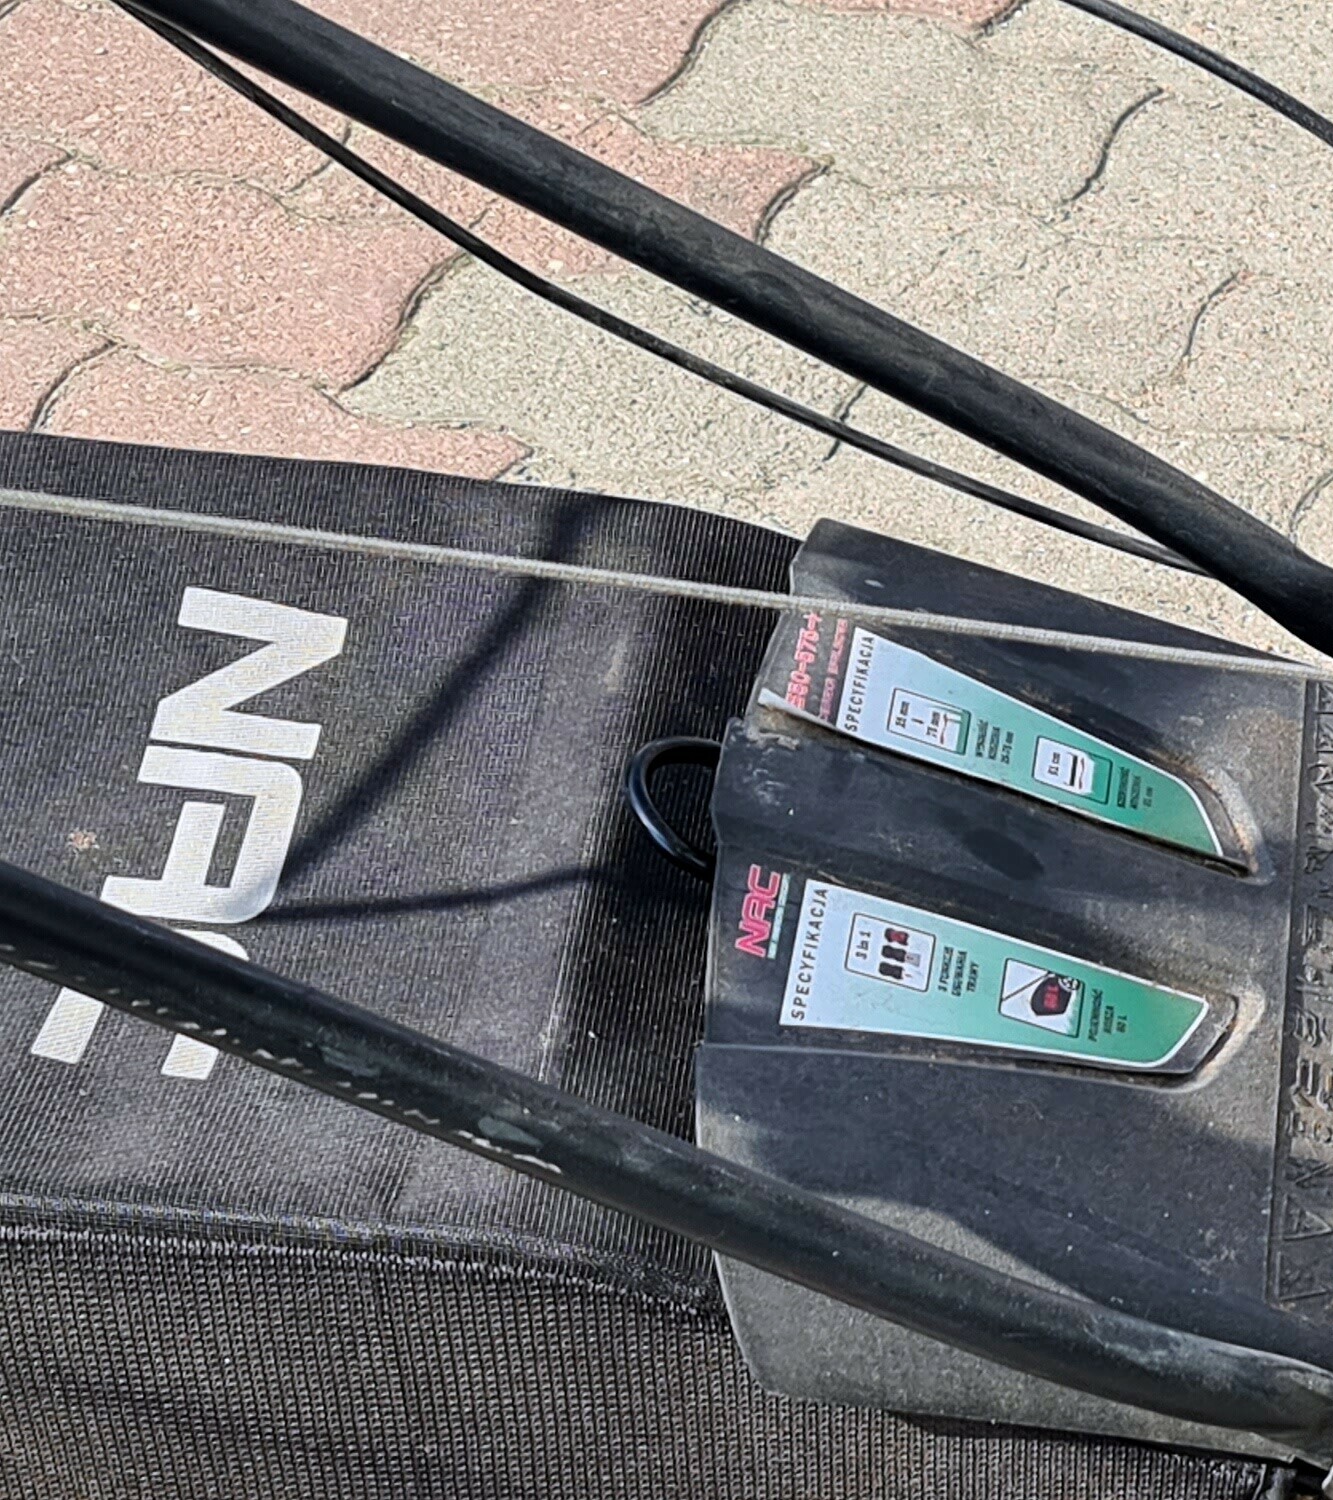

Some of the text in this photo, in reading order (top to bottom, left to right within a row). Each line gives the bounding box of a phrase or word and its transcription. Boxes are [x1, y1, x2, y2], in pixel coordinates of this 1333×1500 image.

[844, 636, 874, 732] SPECYFIKACJA
[735, 863, 781, 959] NAC
[791, 889, 829, 1021] SPECYFIKACJA
